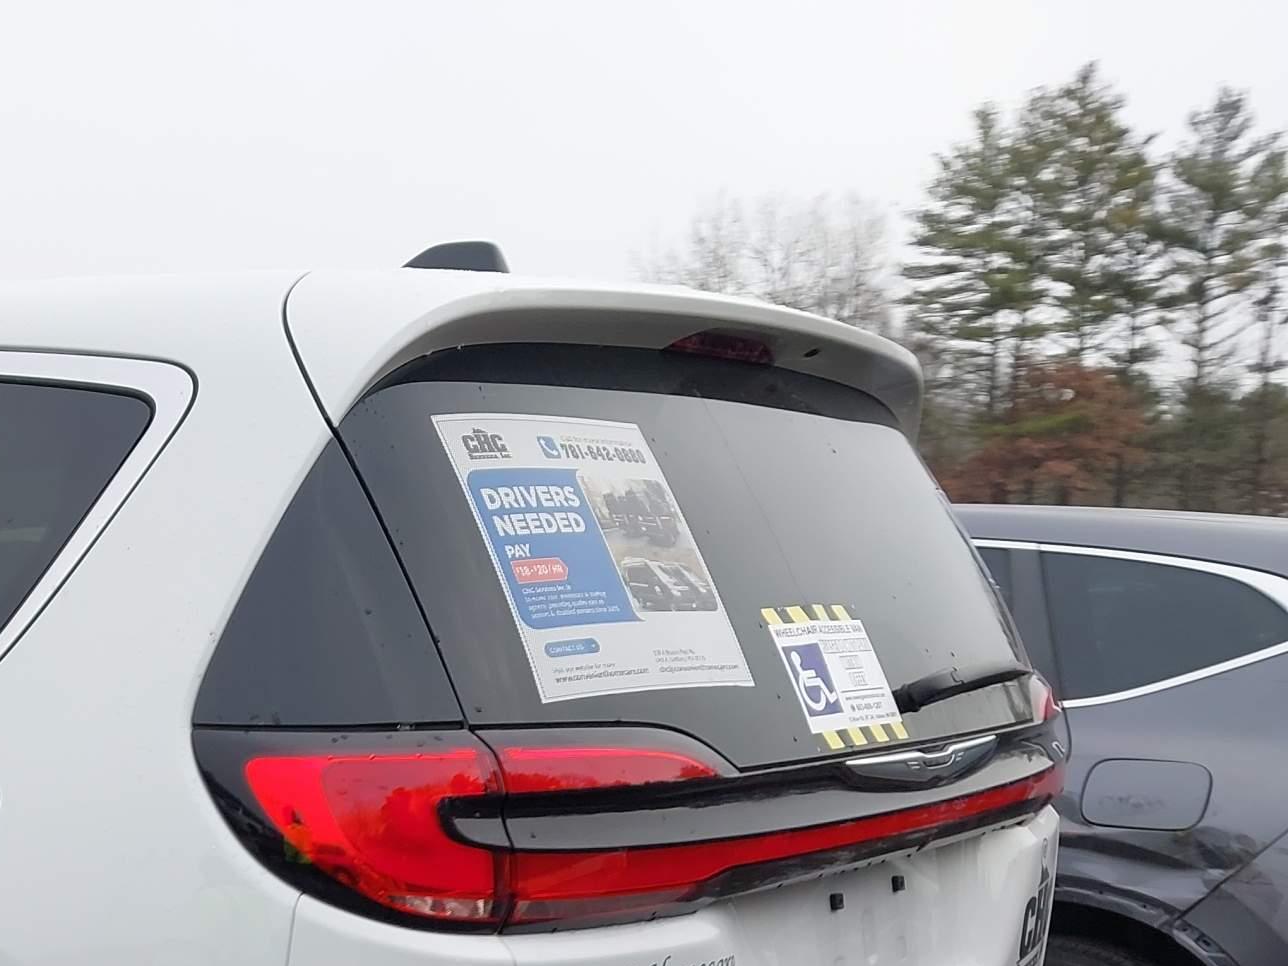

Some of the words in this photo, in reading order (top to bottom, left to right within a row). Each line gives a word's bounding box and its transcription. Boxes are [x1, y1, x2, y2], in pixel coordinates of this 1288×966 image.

[462, 434, 507, 452] CHC
[480, 485, 581, 511] DRIVERS
[492, 512, 586, 537] NEEDED
[504, 544, 532, 559] PAY
[774, 624, 817, 638] WHEELCHAIR
